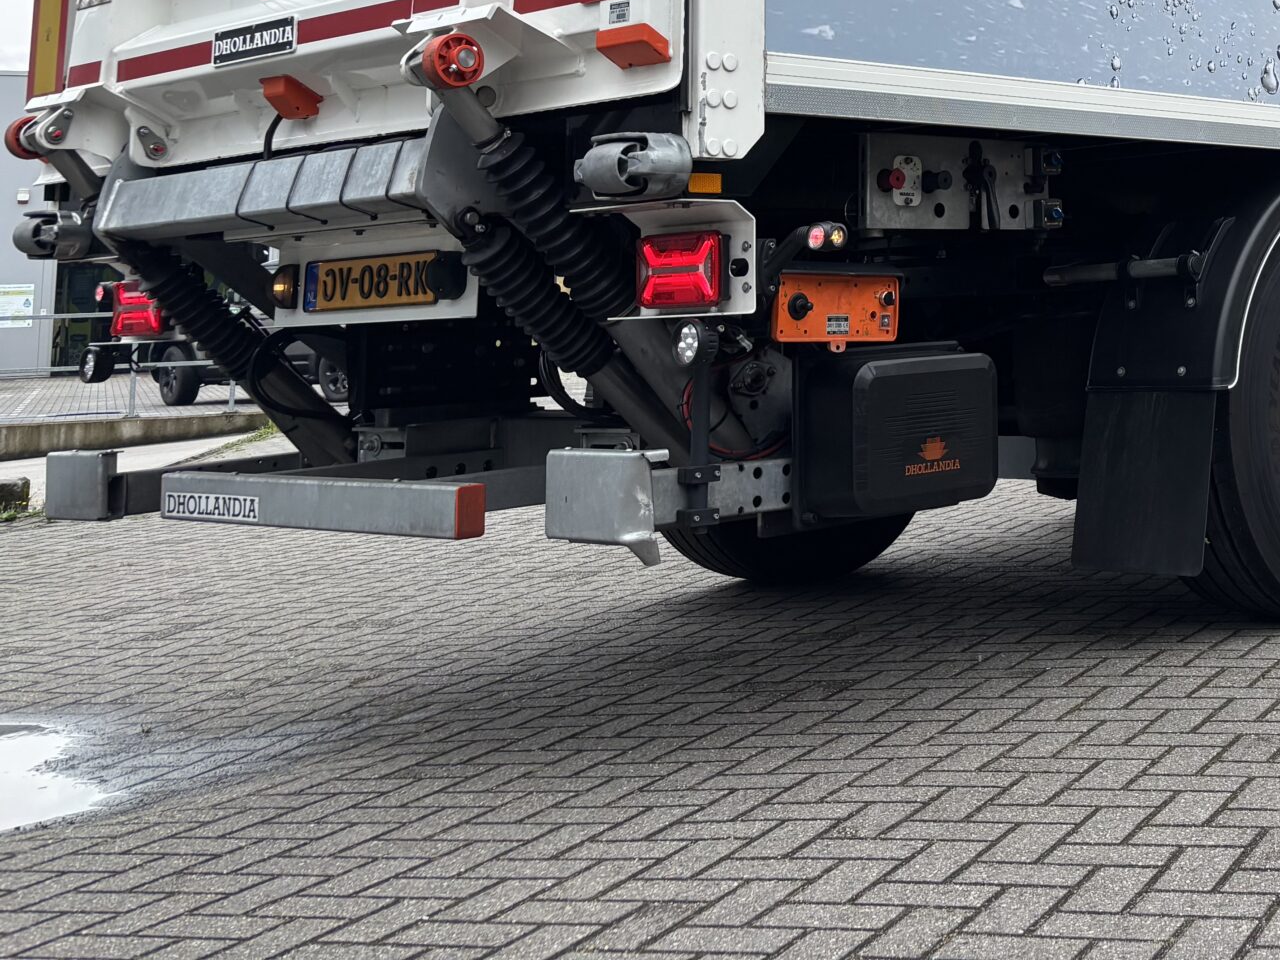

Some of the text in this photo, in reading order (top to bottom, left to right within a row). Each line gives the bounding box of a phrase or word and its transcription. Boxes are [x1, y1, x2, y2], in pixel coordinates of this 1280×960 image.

[214, 25, 294, 57] DHOLLANDIA
[307, 293, 317, 302] NL
[904, 459, 961, 476] DHOLLANDIA
[166, 494, 258, 519] DHOLLANDIA
